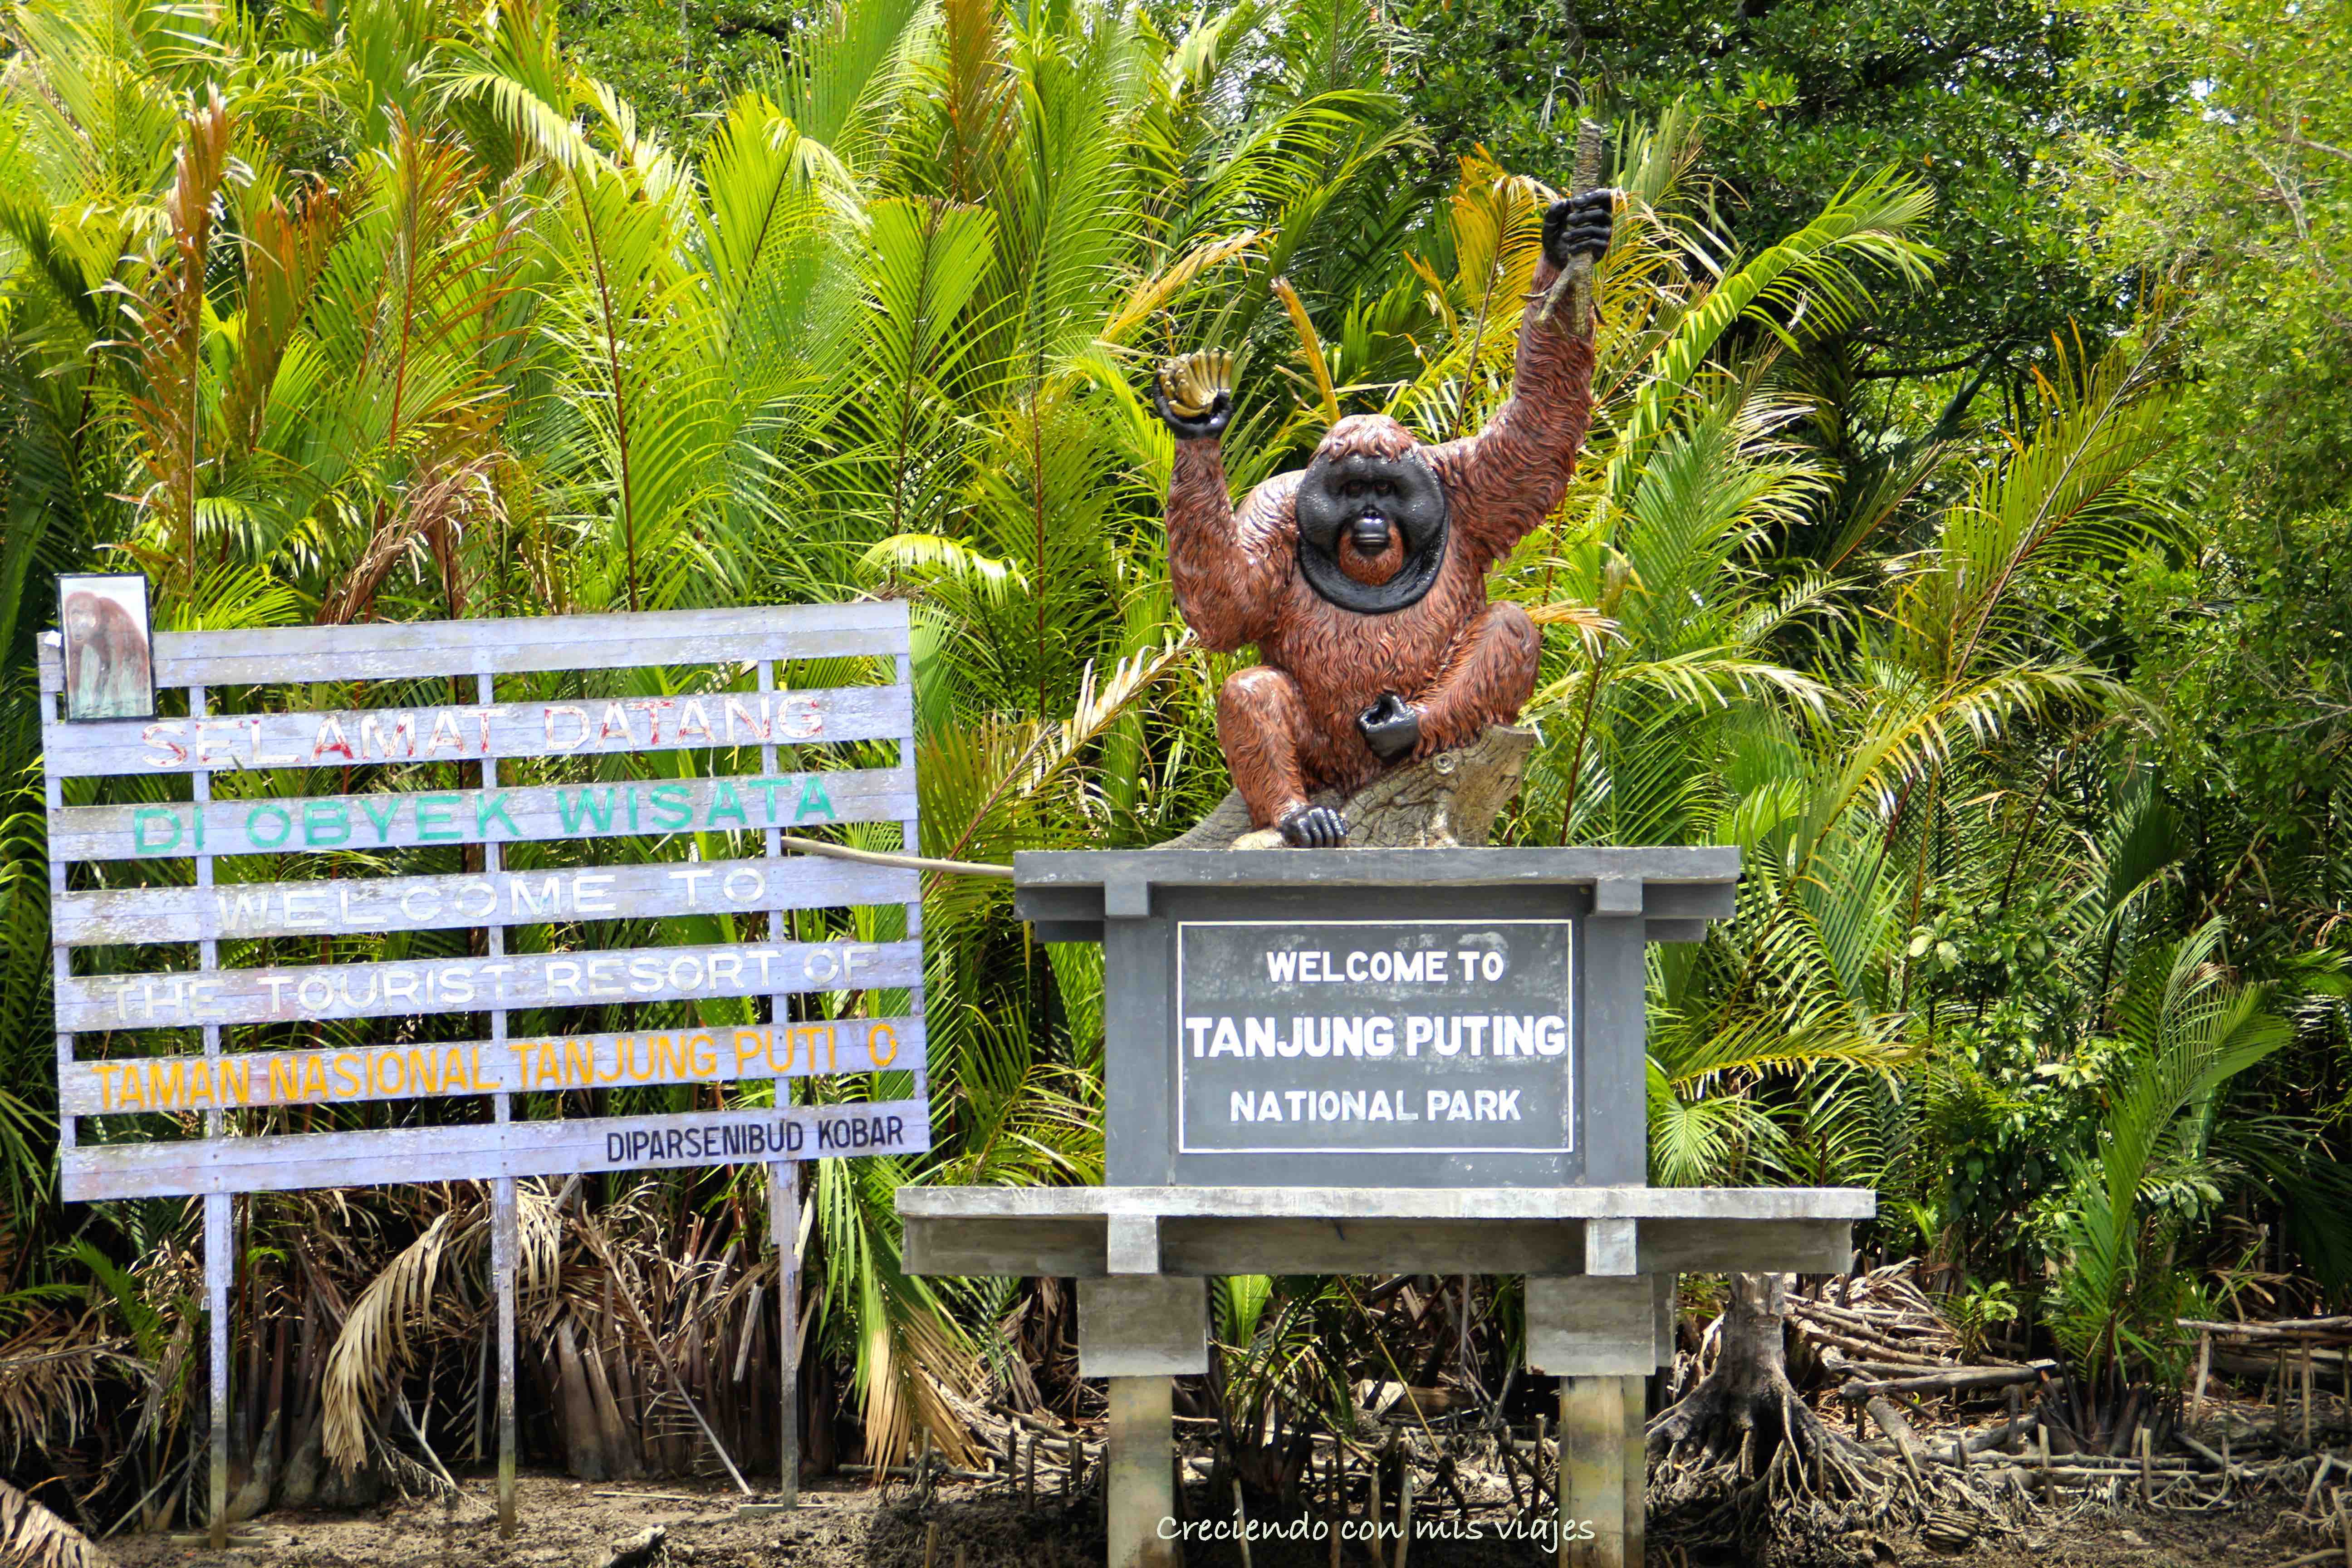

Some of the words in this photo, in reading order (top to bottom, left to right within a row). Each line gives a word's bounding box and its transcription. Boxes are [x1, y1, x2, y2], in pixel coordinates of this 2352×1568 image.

[142, 710, 505, 767] SELAMAT
[544, 694, 823, 751] DATANG
[134, 806, 204, 855] DI
[245, 793, 522, 848] OBYEK
[556, 777, 836, 834] WISATA
[218, 875, 616, 930] WELCOME
[668, 867, 766, 906] TO
[103, 979, 227, 1021] THE
[258, 965, 515, 1014] TOURIST
[545, 950, 782, 998] RESORT
[804, 944, 879, 984] OF
[1267, 951, 1449, 982] WELCOME
[1458, 951, 1504, 981] TO
[1186, 1016, 1395, 1058] TANJUNG
[1406, 1015, 1565, 1056] PUTING
[92, 1059, 250, 1110] TAMAN
[269, 1048, 501, 1101] NASIONAL
[509, 1034, 717, 1088] TANJUNG
[1230, 1090, 1418, 1122] NATIONAL
[1427, 1090, 1521, 1121] PARK
[608, 1121, 803, 1162] DIPARSENIBUD
[818, 1115, 904, 1149] KOBAR
